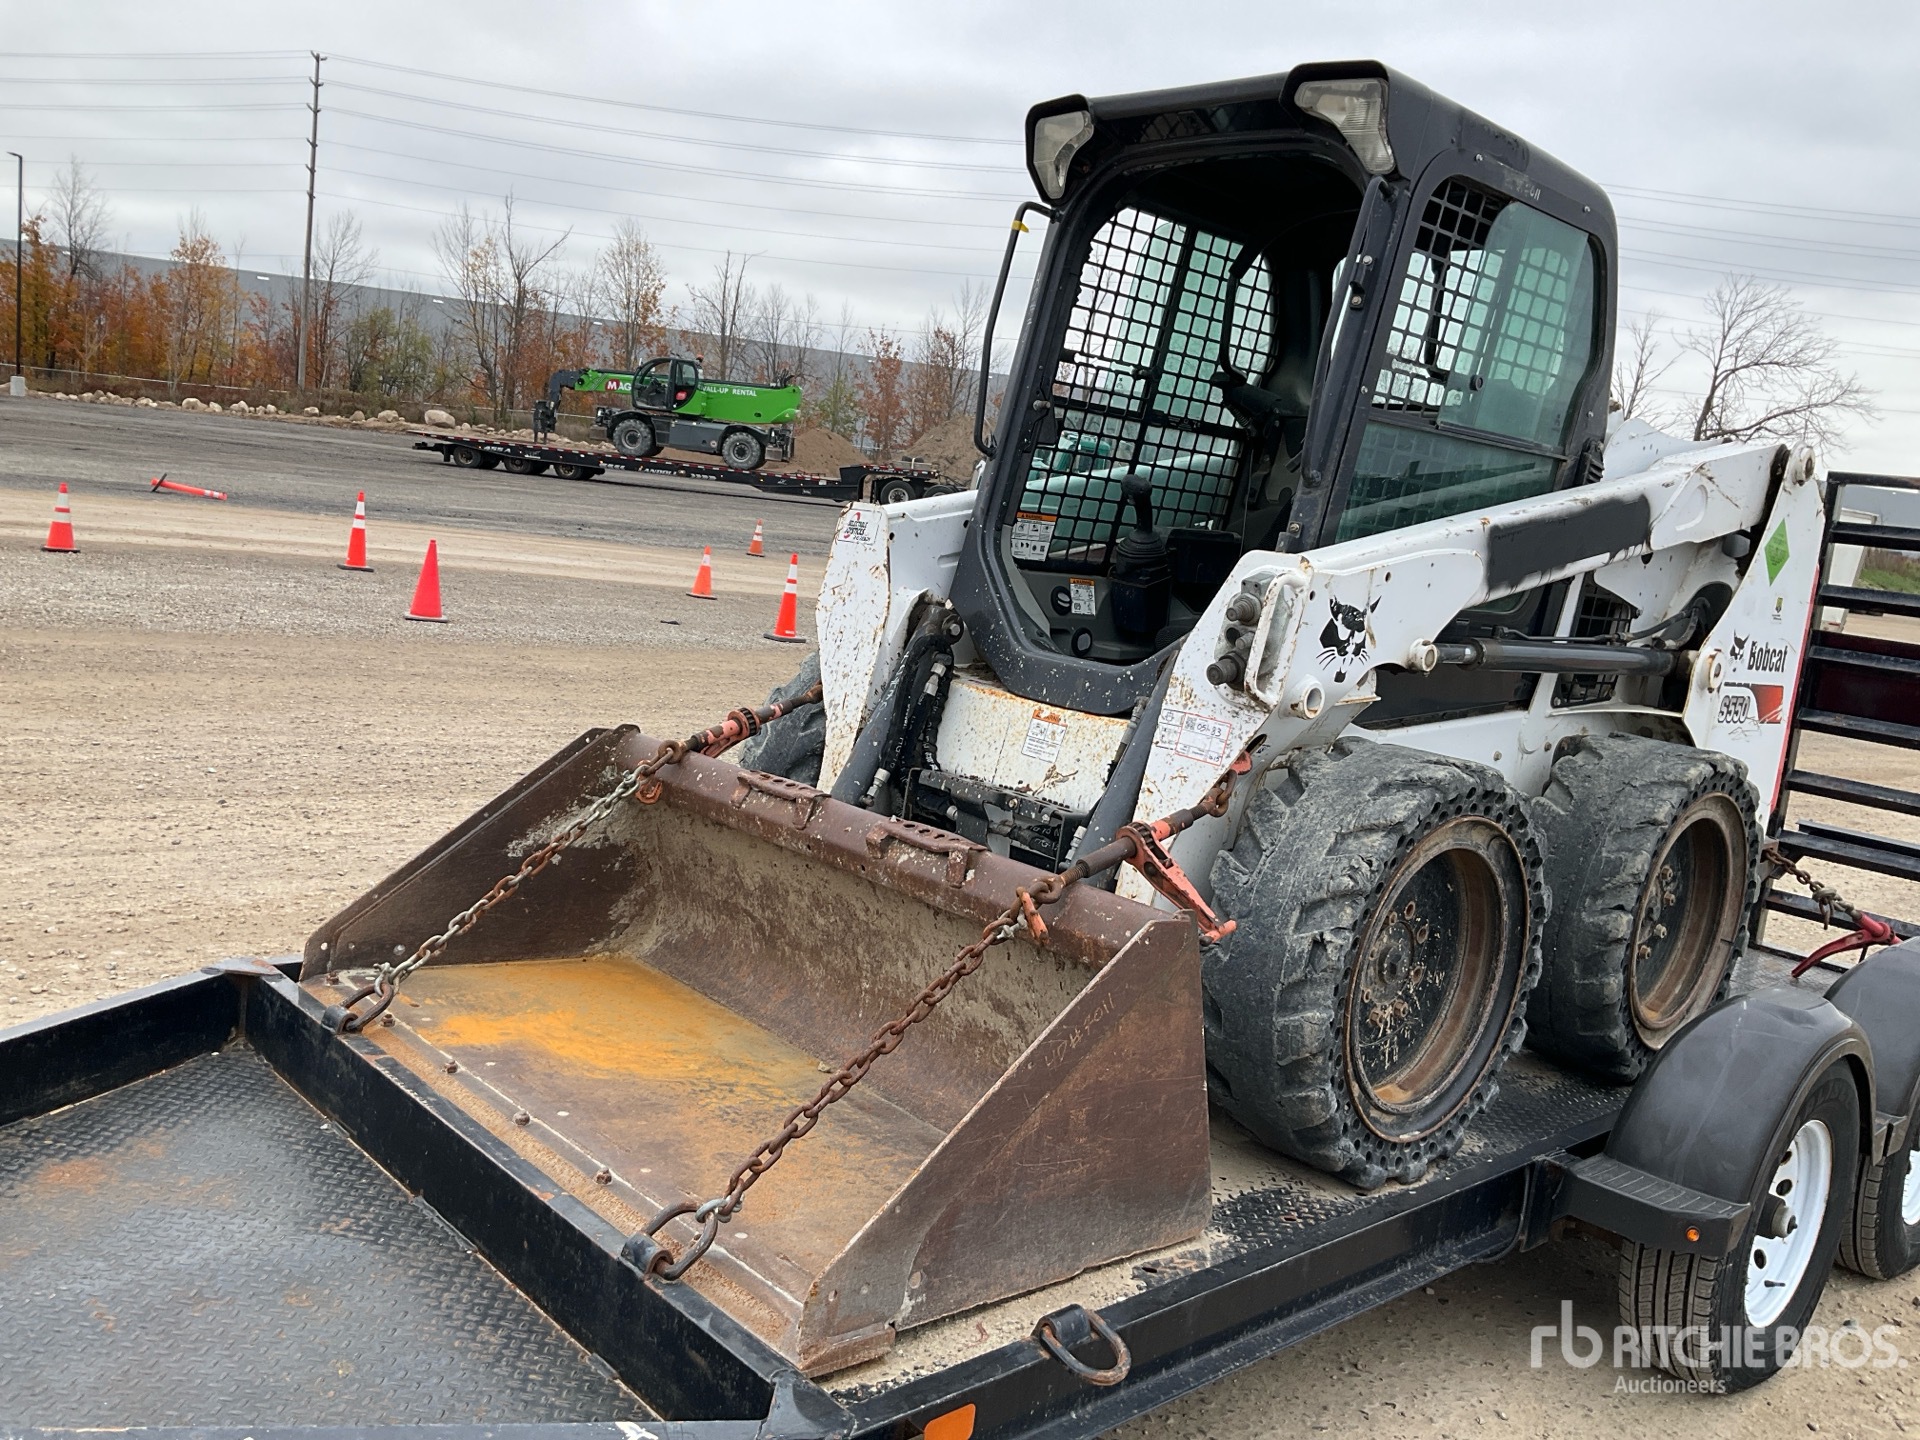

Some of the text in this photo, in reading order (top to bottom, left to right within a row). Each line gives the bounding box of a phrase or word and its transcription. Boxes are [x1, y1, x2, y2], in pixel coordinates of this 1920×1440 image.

[732, 388, 757, 397] RENTAL
[1747, 640, 1788, 673] Bobcat
[1718, 695, 1751, 724] S550
